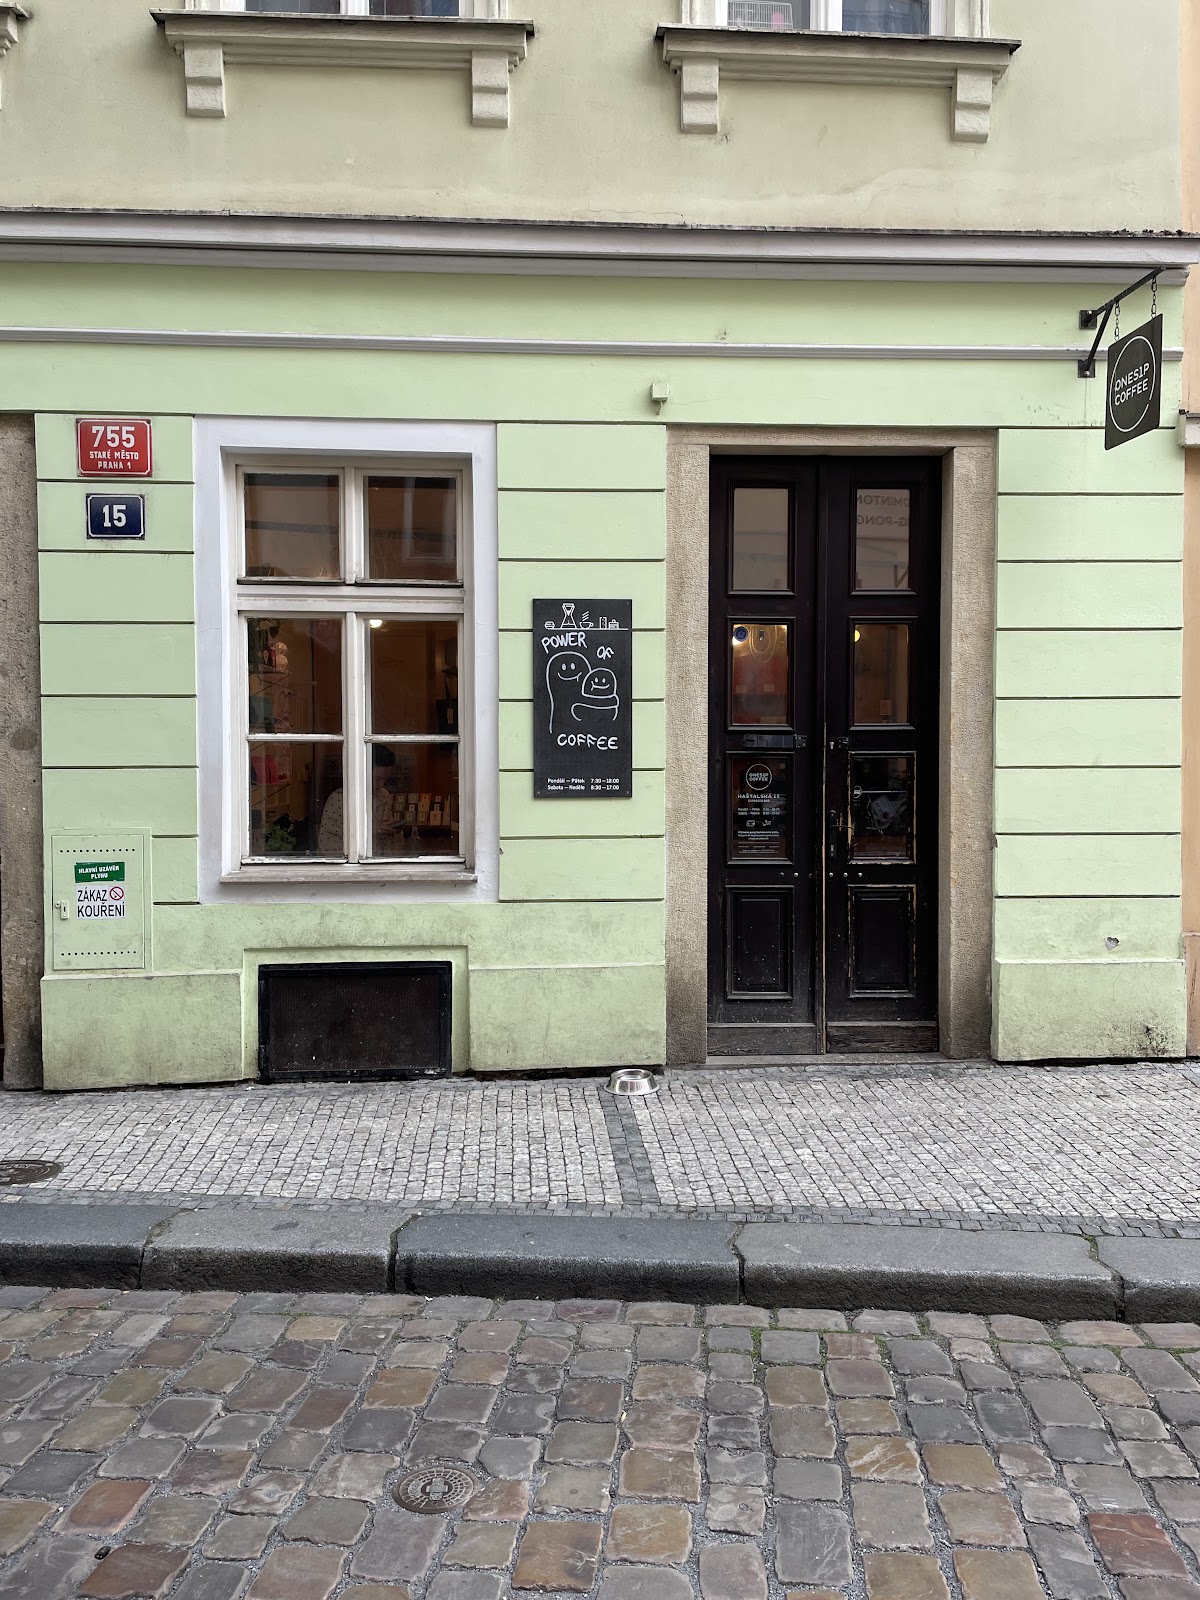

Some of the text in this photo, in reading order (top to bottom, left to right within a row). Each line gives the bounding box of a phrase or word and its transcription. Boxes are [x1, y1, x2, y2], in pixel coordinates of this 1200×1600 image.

[1114, 378, 1149, 406] COFFEE
[92, 426, 135, 448] 755
[89, 449, 139, 460] STARÉ MĚSTO
[97, 461, 131, 470] PRAHA 1
[102, 504, 127, 528] 15
[541, 631, 588, 654] POWER
[557, 733, 619, 751] COFFEE
[78, 864, 120, 874] HLAVNÍ UZÁVĚR
[90, 872, 109, 880] PLYNU
[77, 887, 108, 902] ZÁKAZ
[77, 901, 125, 918] KOUŘENÍ
